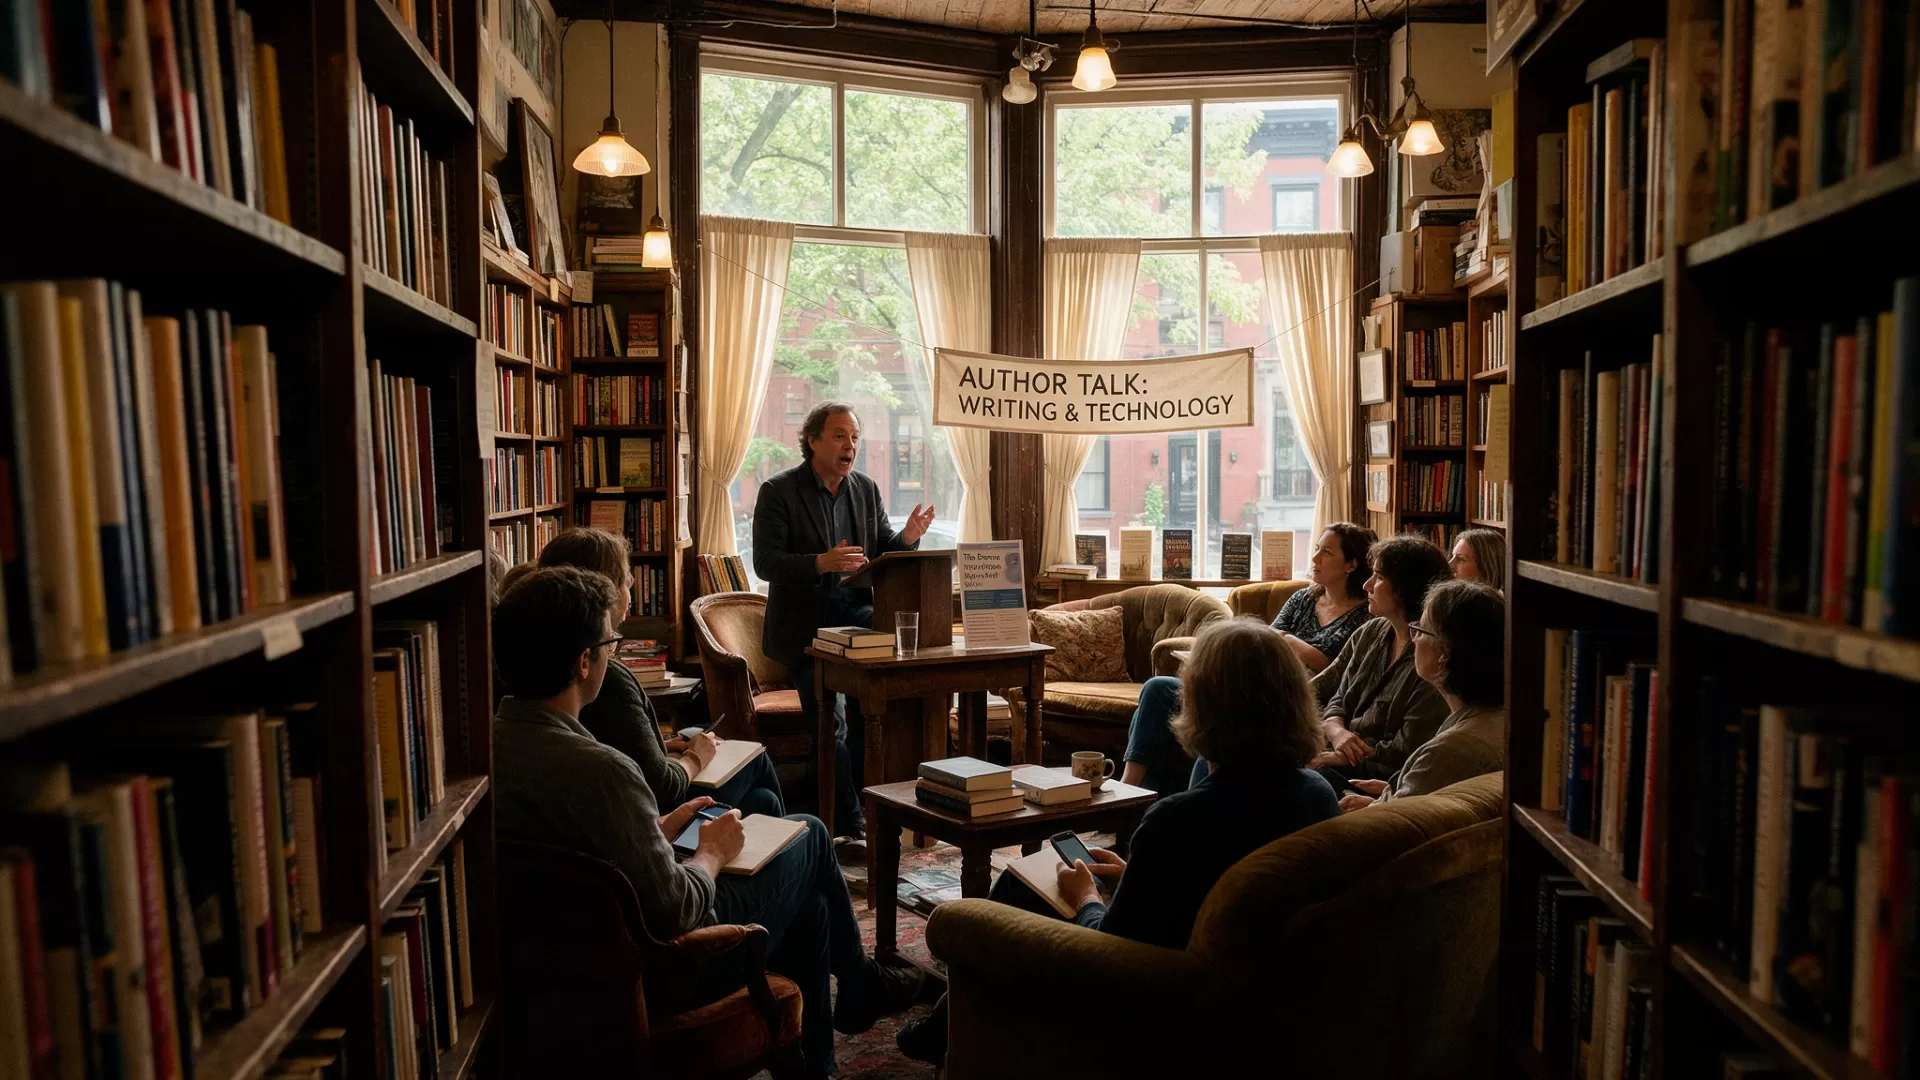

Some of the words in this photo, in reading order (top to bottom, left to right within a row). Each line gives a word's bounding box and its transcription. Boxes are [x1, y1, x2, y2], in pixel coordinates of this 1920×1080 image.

[958, 365, 1068, 396] AUTHOR
[1077, 373, 1148, 396] TALK:
[958, 394, 1057, 421] WRITING
[1065, 403, 1079, 422] &
[1085, 394, 1234, 422] TECHNOLOGY
